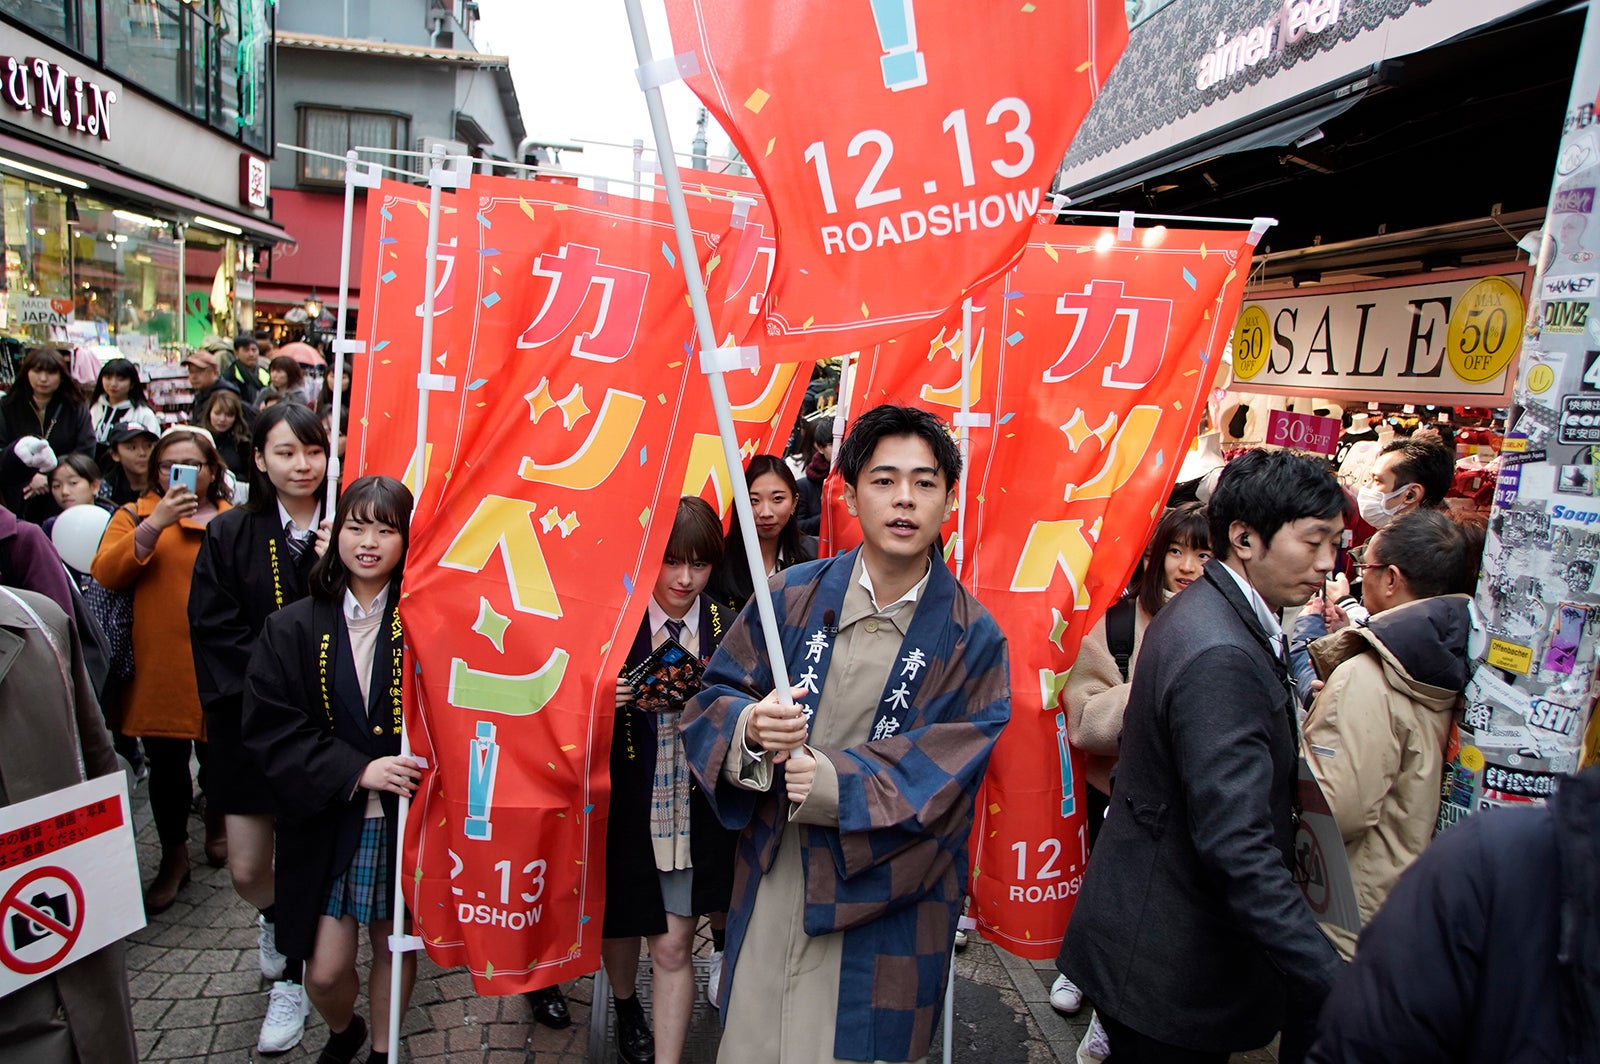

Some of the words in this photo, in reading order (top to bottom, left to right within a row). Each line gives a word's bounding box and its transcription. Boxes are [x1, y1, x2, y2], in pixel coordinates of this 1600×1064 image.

[1196, 28, 1275, 91] aimer
[804, 97, 1035, 214] 12.13
[821, 187, 1040, 254] ROADSHOW
[1474, 292, 1503, 308] MAX
[23, 311, 67, 323] JAPAN
[1267, 296, 1453, 378] SALE
[1241, 361, 1257, 372] OFF
[1464, 354, 1493, 371] OFF
[1304, 432, 1331, 449] OFF
[1552, 505, 1600, 525] Soap
[872, 648, 927, 741] 青木館
